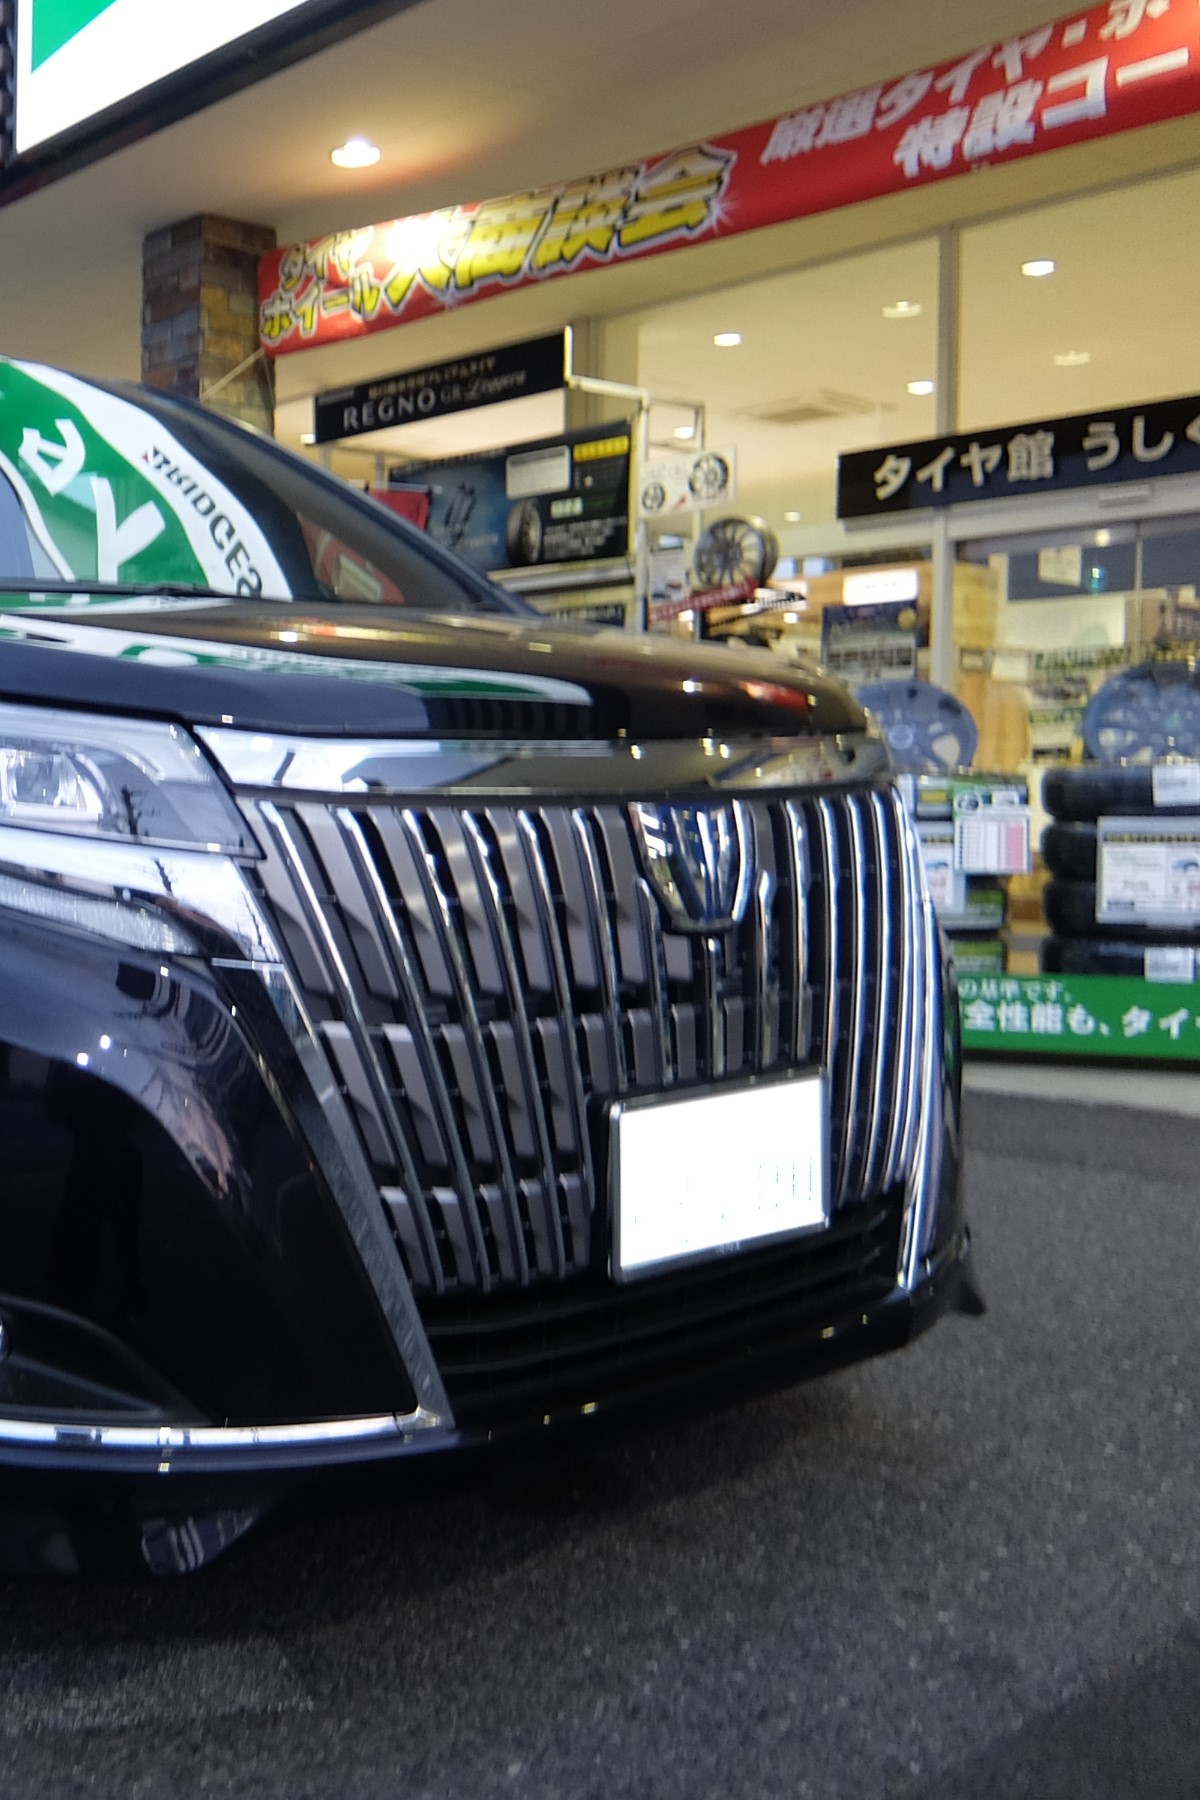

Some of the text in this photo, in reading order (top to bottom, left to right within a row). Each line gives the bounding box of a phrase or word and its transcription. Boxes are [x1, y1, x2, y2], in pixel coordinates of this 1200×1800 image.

[894, 46, 1190, 178] 特設コー
[280, 224, 374, 290] タイヤ
[261, 262, 382, 338] ホイール
[343, 387, 435, 431] REGNO
[874, 431, 1055, 499] タイヤ館
[963, 1000, 1200, 1040] 全性能も、タイ
